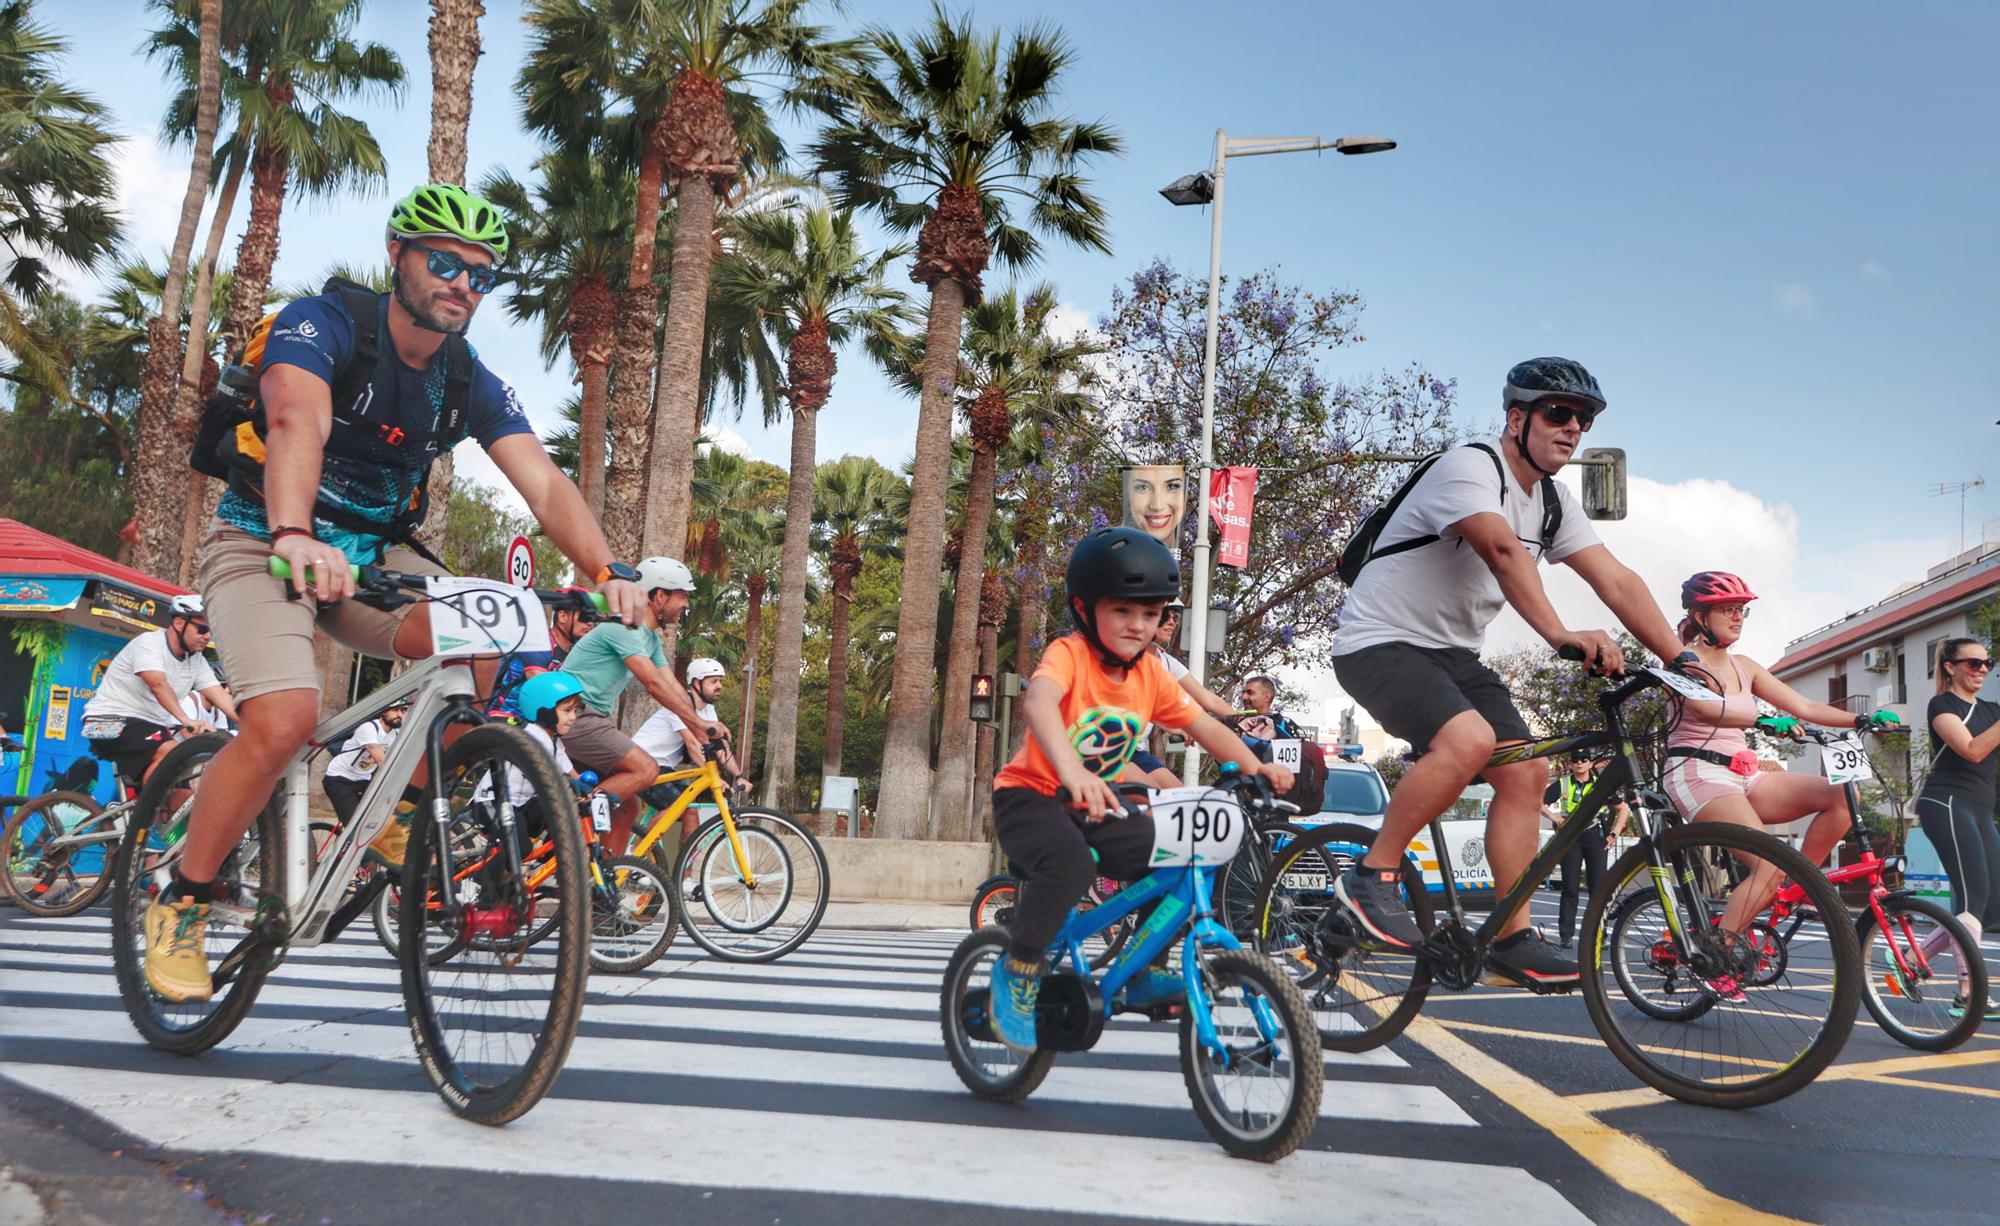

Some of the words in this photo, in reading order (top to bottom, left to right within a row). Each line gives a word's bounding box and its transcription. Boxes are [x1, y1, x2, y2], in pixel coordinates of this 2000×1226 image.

[514, 556, 529, 580] 30
[449, 594, 527, 628] 191
[1278, 747, 1298, 763] 403
[1832, 749, 1864, 770] 397
[1171, 806, 1231, 843] 190
[1299, 876, 1322, 888] LXY
[1452, 866, 1488, 879] OLICÍA
